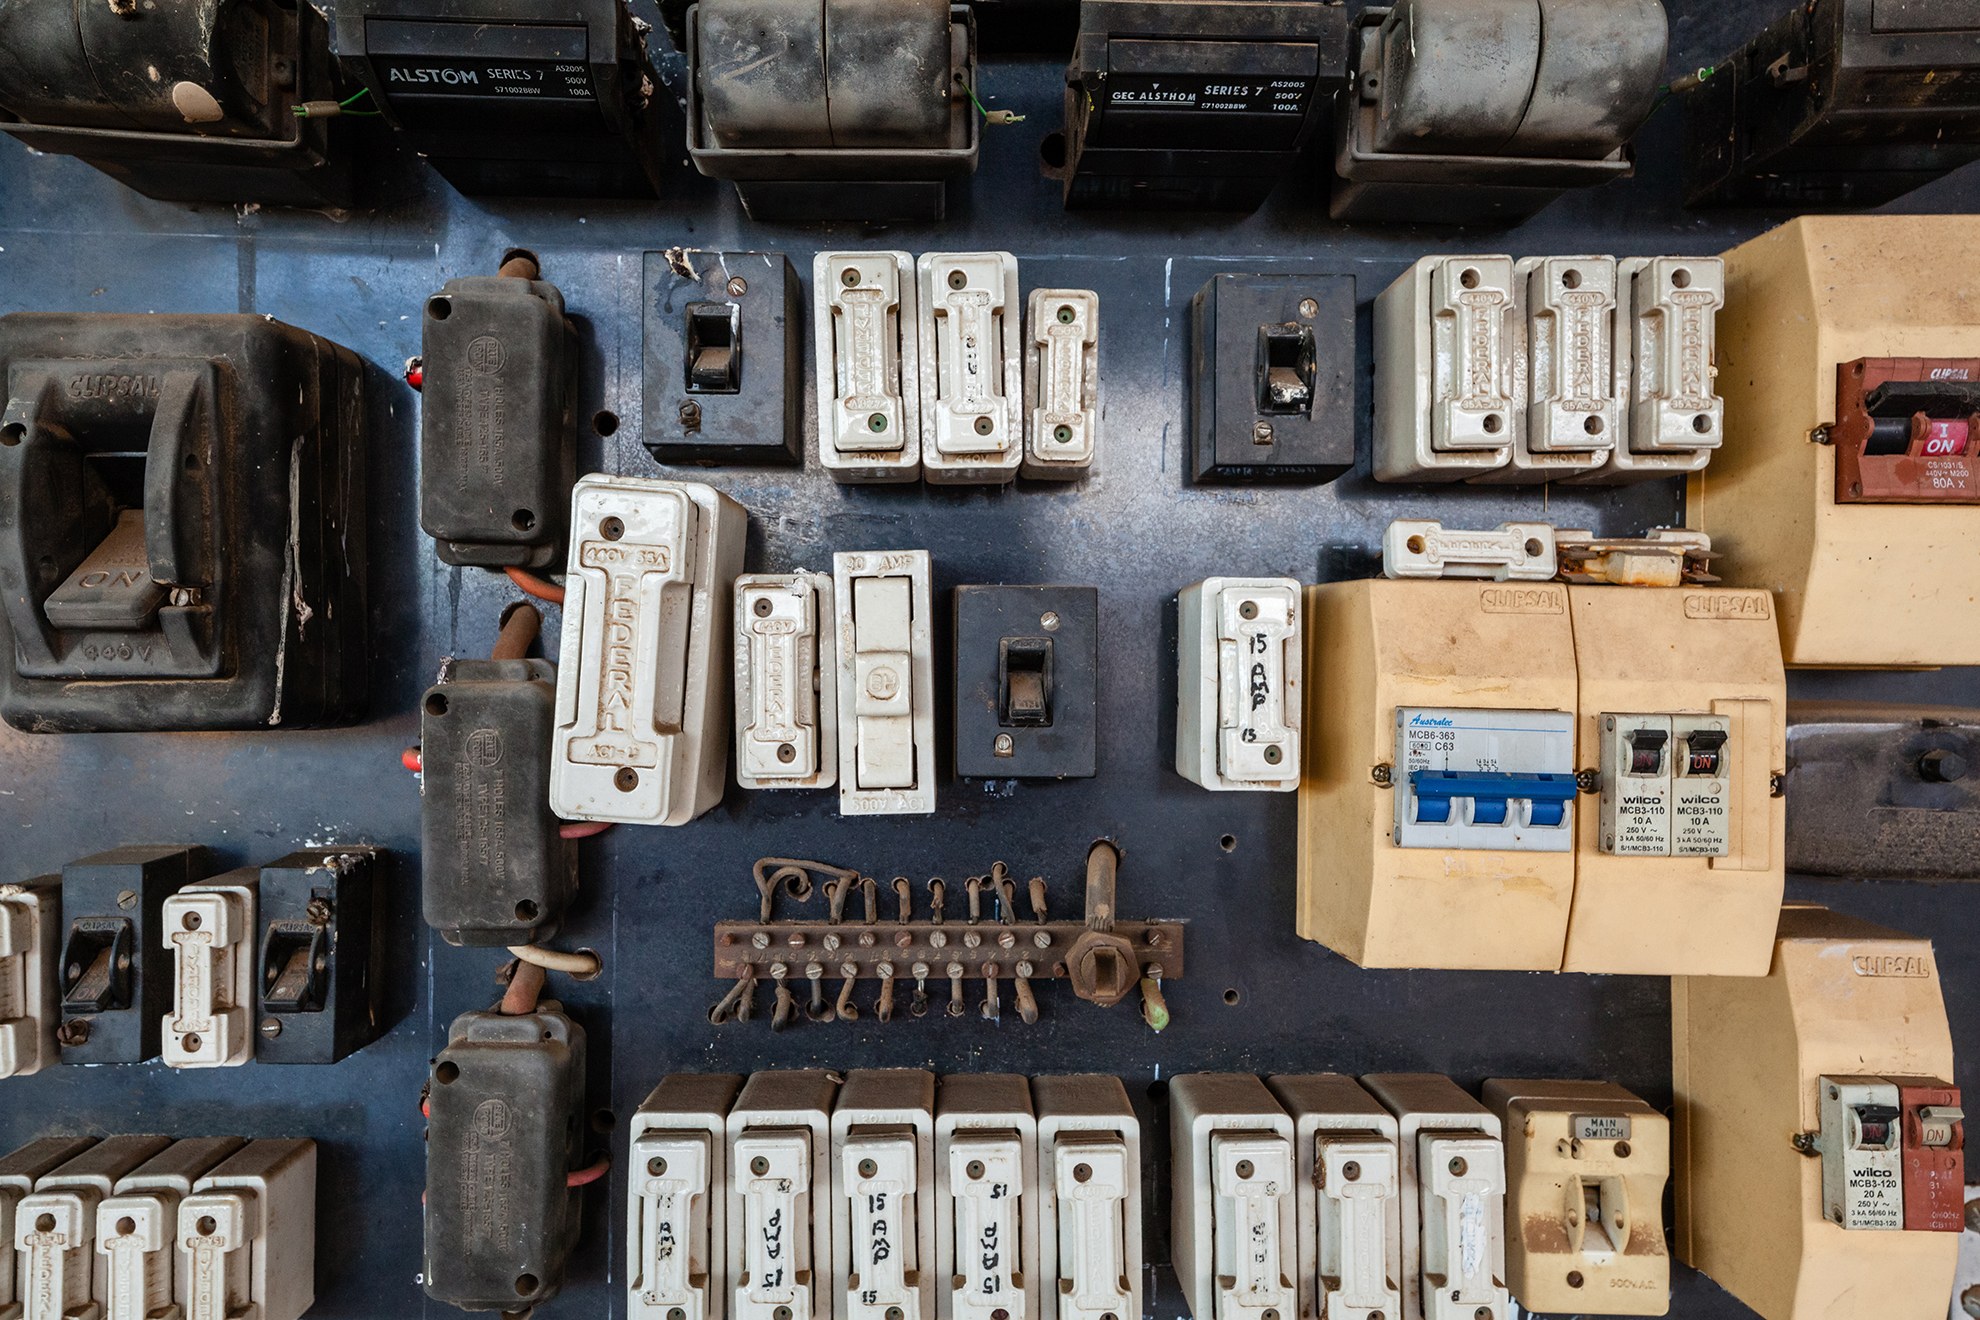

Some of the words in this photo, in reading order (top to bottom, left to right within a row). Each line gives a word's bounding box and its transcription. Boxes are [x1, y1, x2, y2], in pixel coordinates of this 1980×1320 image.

[390, 67, 479, 84] ALSTOM
[487, 68, 531, 80] SERIES
[536, 69, 544, 81] 7
[565, 76, 587, 84] 500V
[569, 88, 591, 96] 100A
[1112, 92, 1135, 100] GEC
[1139, 92, 1196, 101] ALSTHOM
[1204, 85, 1249, 96] SERIES
[1254, 86, 1264, 97] 7
[1272, 103, 1298, 111] 100A
[1474, 308, 1490, 396] FEDERAL
[1575, 308, 1590, 397] FEDERAL
[1684, 308, 1700, 396] FEDERAL
[1930, 368, 1969, 380] CLIPSAL
[66, 375, 161, 398] CLIPSAL
[1926, 439, 1955, 453] ON
[1933, 477, 1955, 489] 80A
[1440, 540, 1513, 551] FEDERAL
[586, 546, 628, 562] 440V
[846, 556, 865, 570] 30
[877, 556, 914, 570] AMP
[79, 570, 142, 588] ON
[1481, 588, 1562, 609] CLIPSAL
[1684, 594, 1768, 614] CLIPSAL
[1249, 633, 1267, 654] 15
[83, 644, 151, 663] 440V
[605, 575, 637, 732] FEDERAL
[768, 636, 786, 728] FEDERAL
[1251, 662, 1270, 711] AMP
[1409, 714, 1453, 727] Australec
[1242, 728, 1257, 742] 15
[1409, 730, 1456, 741] MCB6-363
[1434, 742, 1455, 751] C63
[1634, 753, 1652, 766] ON
[1694, 756, 1712, 769] ON
[1623, 796, 1662, 805] wilco
[1680, 795, 1720, 804] wilco
[1620, 807, 1665, 815] MCB3-110
[1677, 807, 1723, 815] MCB3-110
[1632, 817, 1643, 825] 10
[1645, 817, 1653, 825] A
[1690, 818, 1701, 826] 10
[1702, 818, 1710, 826] A
[82, 921, 116, 930] CLIPSAL
[1852, 956, 1927, 976] CLIPSAL
[76, 986, 99, 1000] ON
[1590, 1118, 1617, 1128] MAIN
[1584, 1127, 1624, 1138] SWITCH
[1863, 1125, 1882, 1139] ON
[1926, 1129, 1945, 1142] ON
[1853, 1167, 1892, 1178] wilco
[1850, 1179, 1897, 1188] MCB3-120
[990, 1184, 1008, 1199] 15
[868, 1193, 887, 1213] 15
[763, 1209, 782, 1260] AMP
[872, 1219, 891, 1266] AMP
[980, 1222, 999, 1270] AMP
[762, 1268, 783, 1292] 15
[983, 1275, 1000, 1294] 15
[862, 1290, 878, 1304] 15
